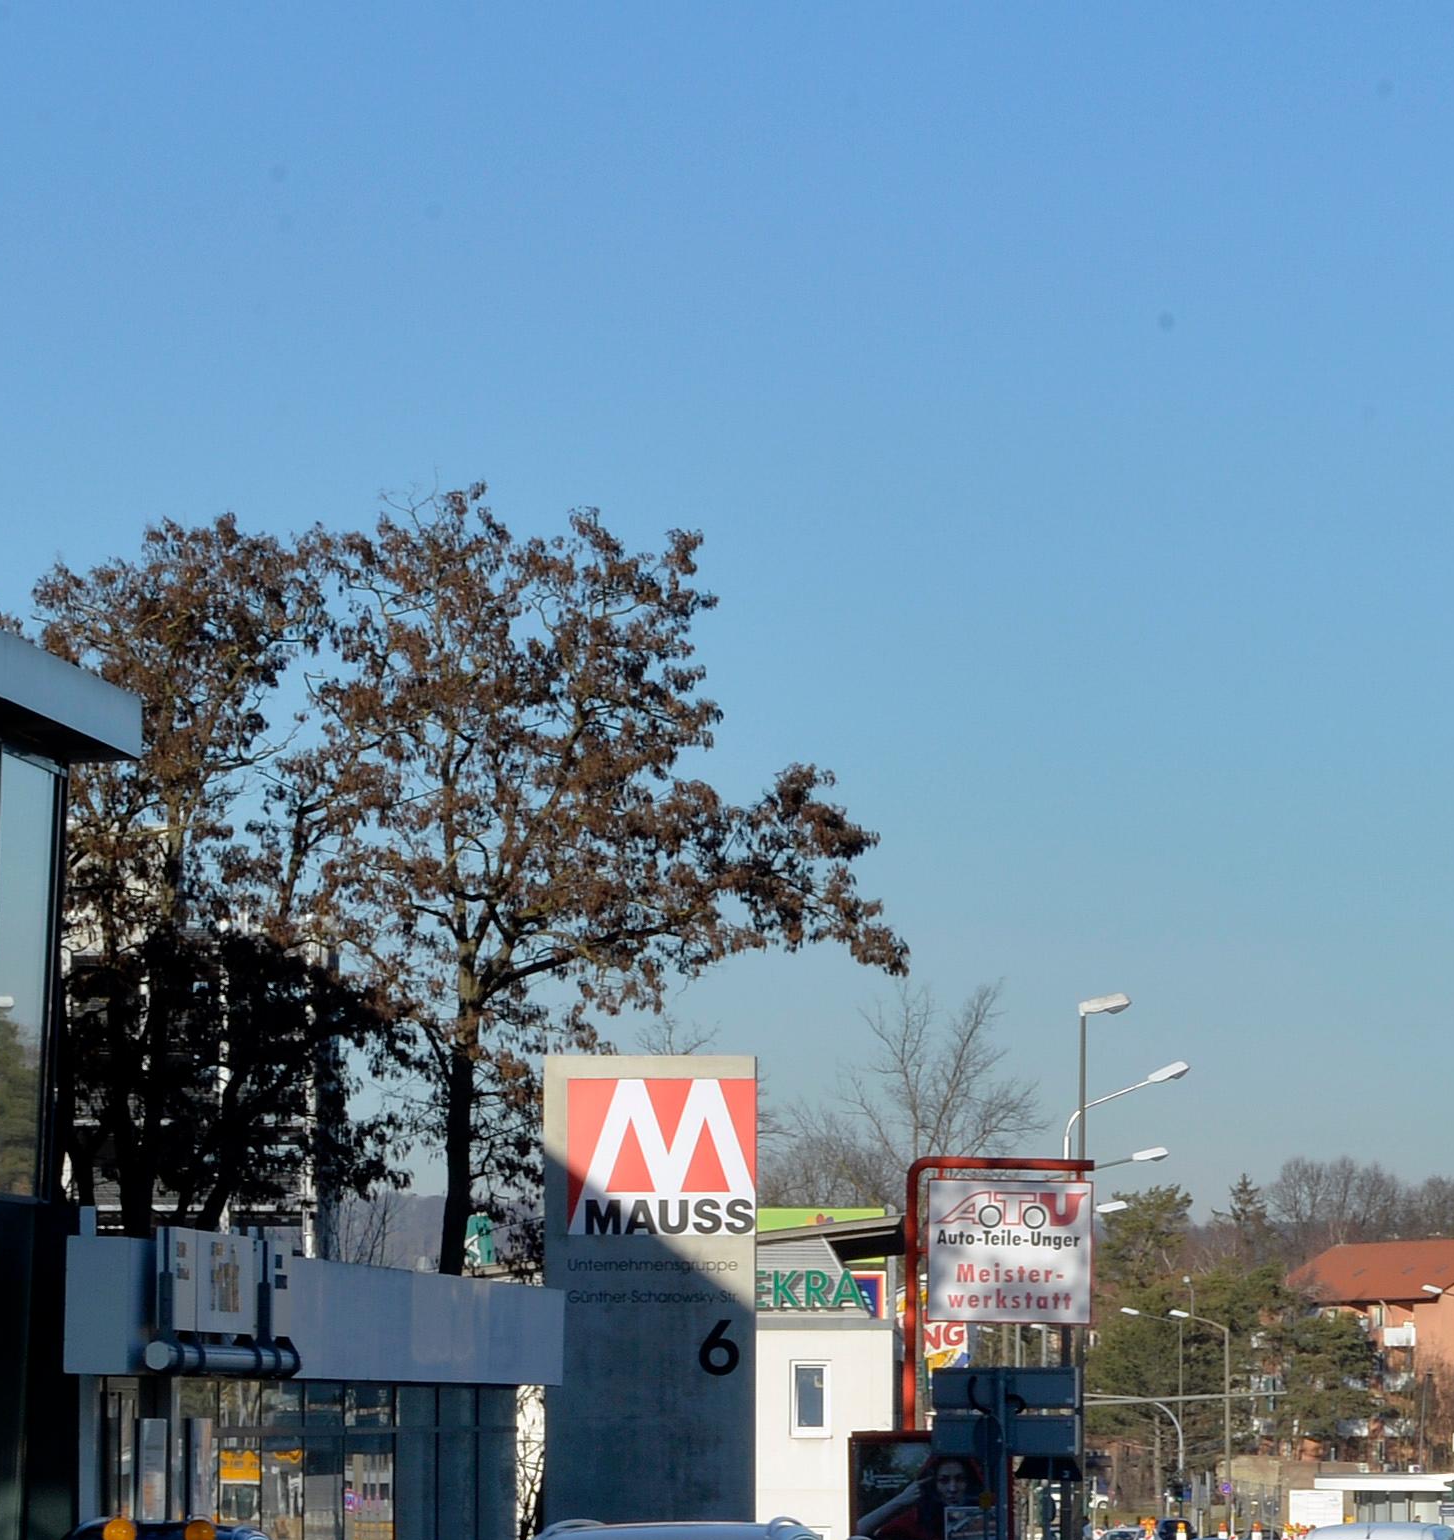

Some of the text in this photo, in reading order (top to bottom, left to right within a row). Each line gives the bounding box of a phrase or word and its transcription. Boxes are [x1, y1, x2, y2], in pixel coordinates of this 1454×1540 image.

[585, 1198, 755, 1235] MAUSS
[937, 1229, 1080, 1250] Auto-Teile-Unger
[567, 1257, 738, 1275] Unternehmensgruppe
[955, 1262, 1064, 1283] Meister-
[947, 1288, 1072, 1310] werkstatt
[698, 1319, 740, 1376] 6
